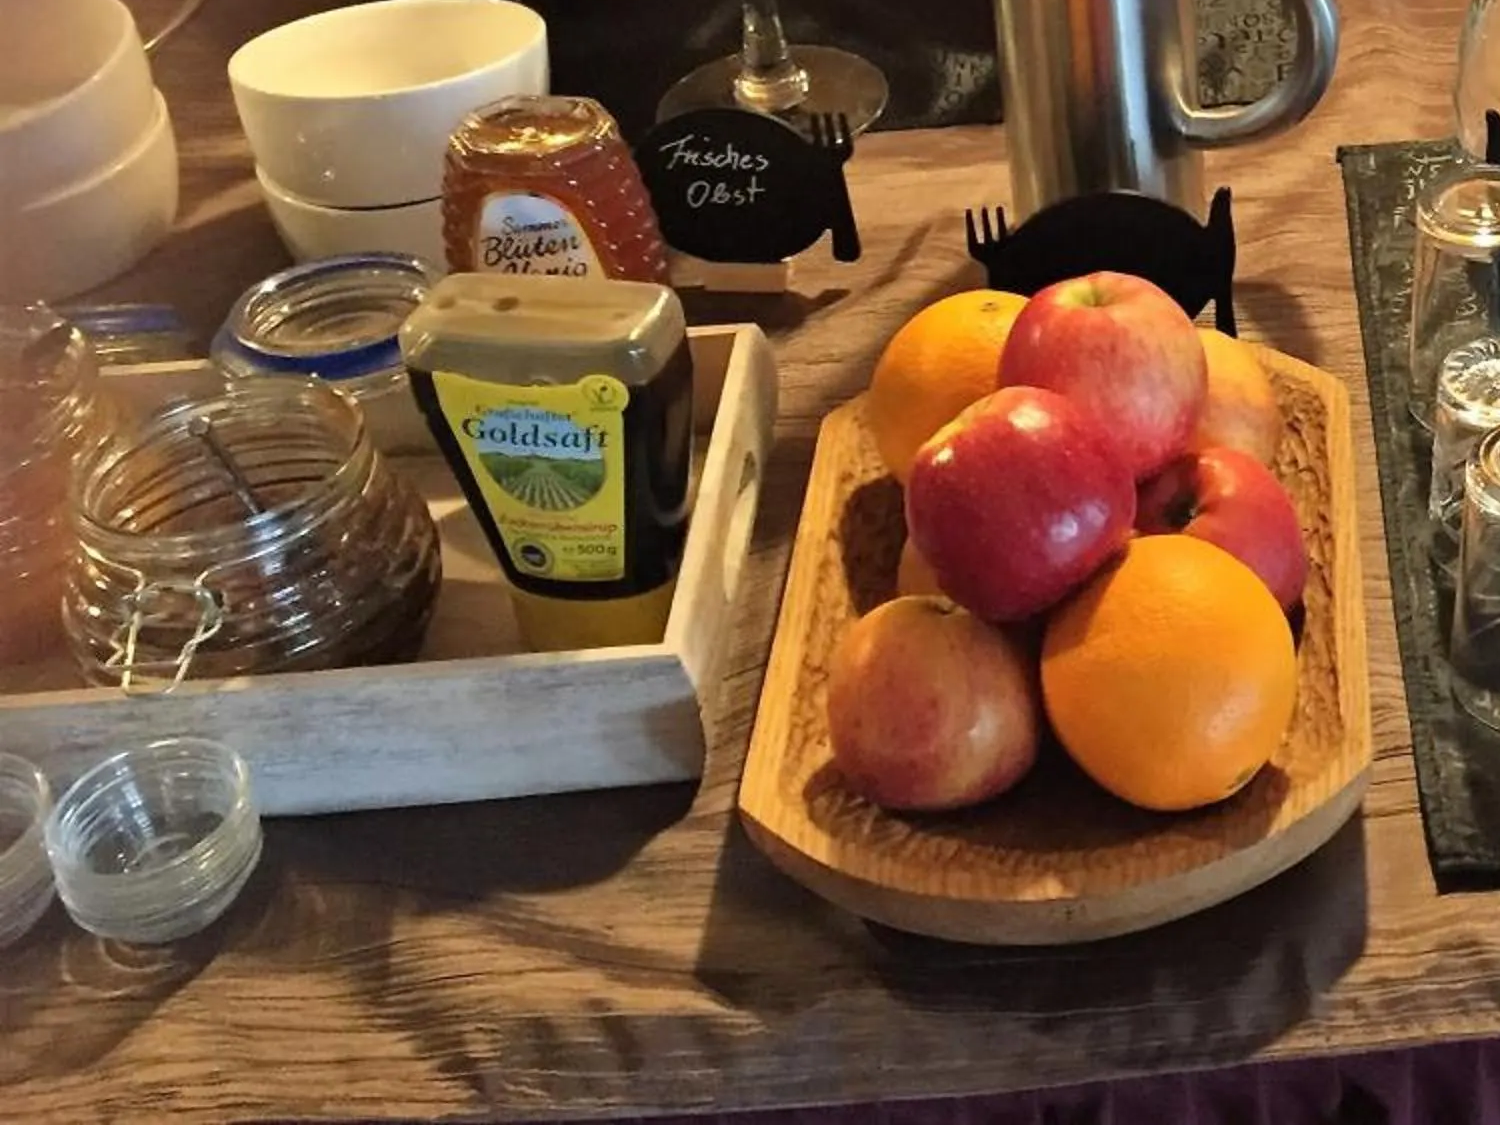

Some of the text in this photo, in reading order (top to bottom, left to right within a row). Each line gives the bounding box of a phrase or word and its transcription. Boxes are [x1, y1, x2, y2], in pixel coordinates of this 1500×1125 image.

[659, 134, 769, 171] Frisches
[686, 176, 766, 208] Obst
[461, 417, 609, 453] Goldsaft
